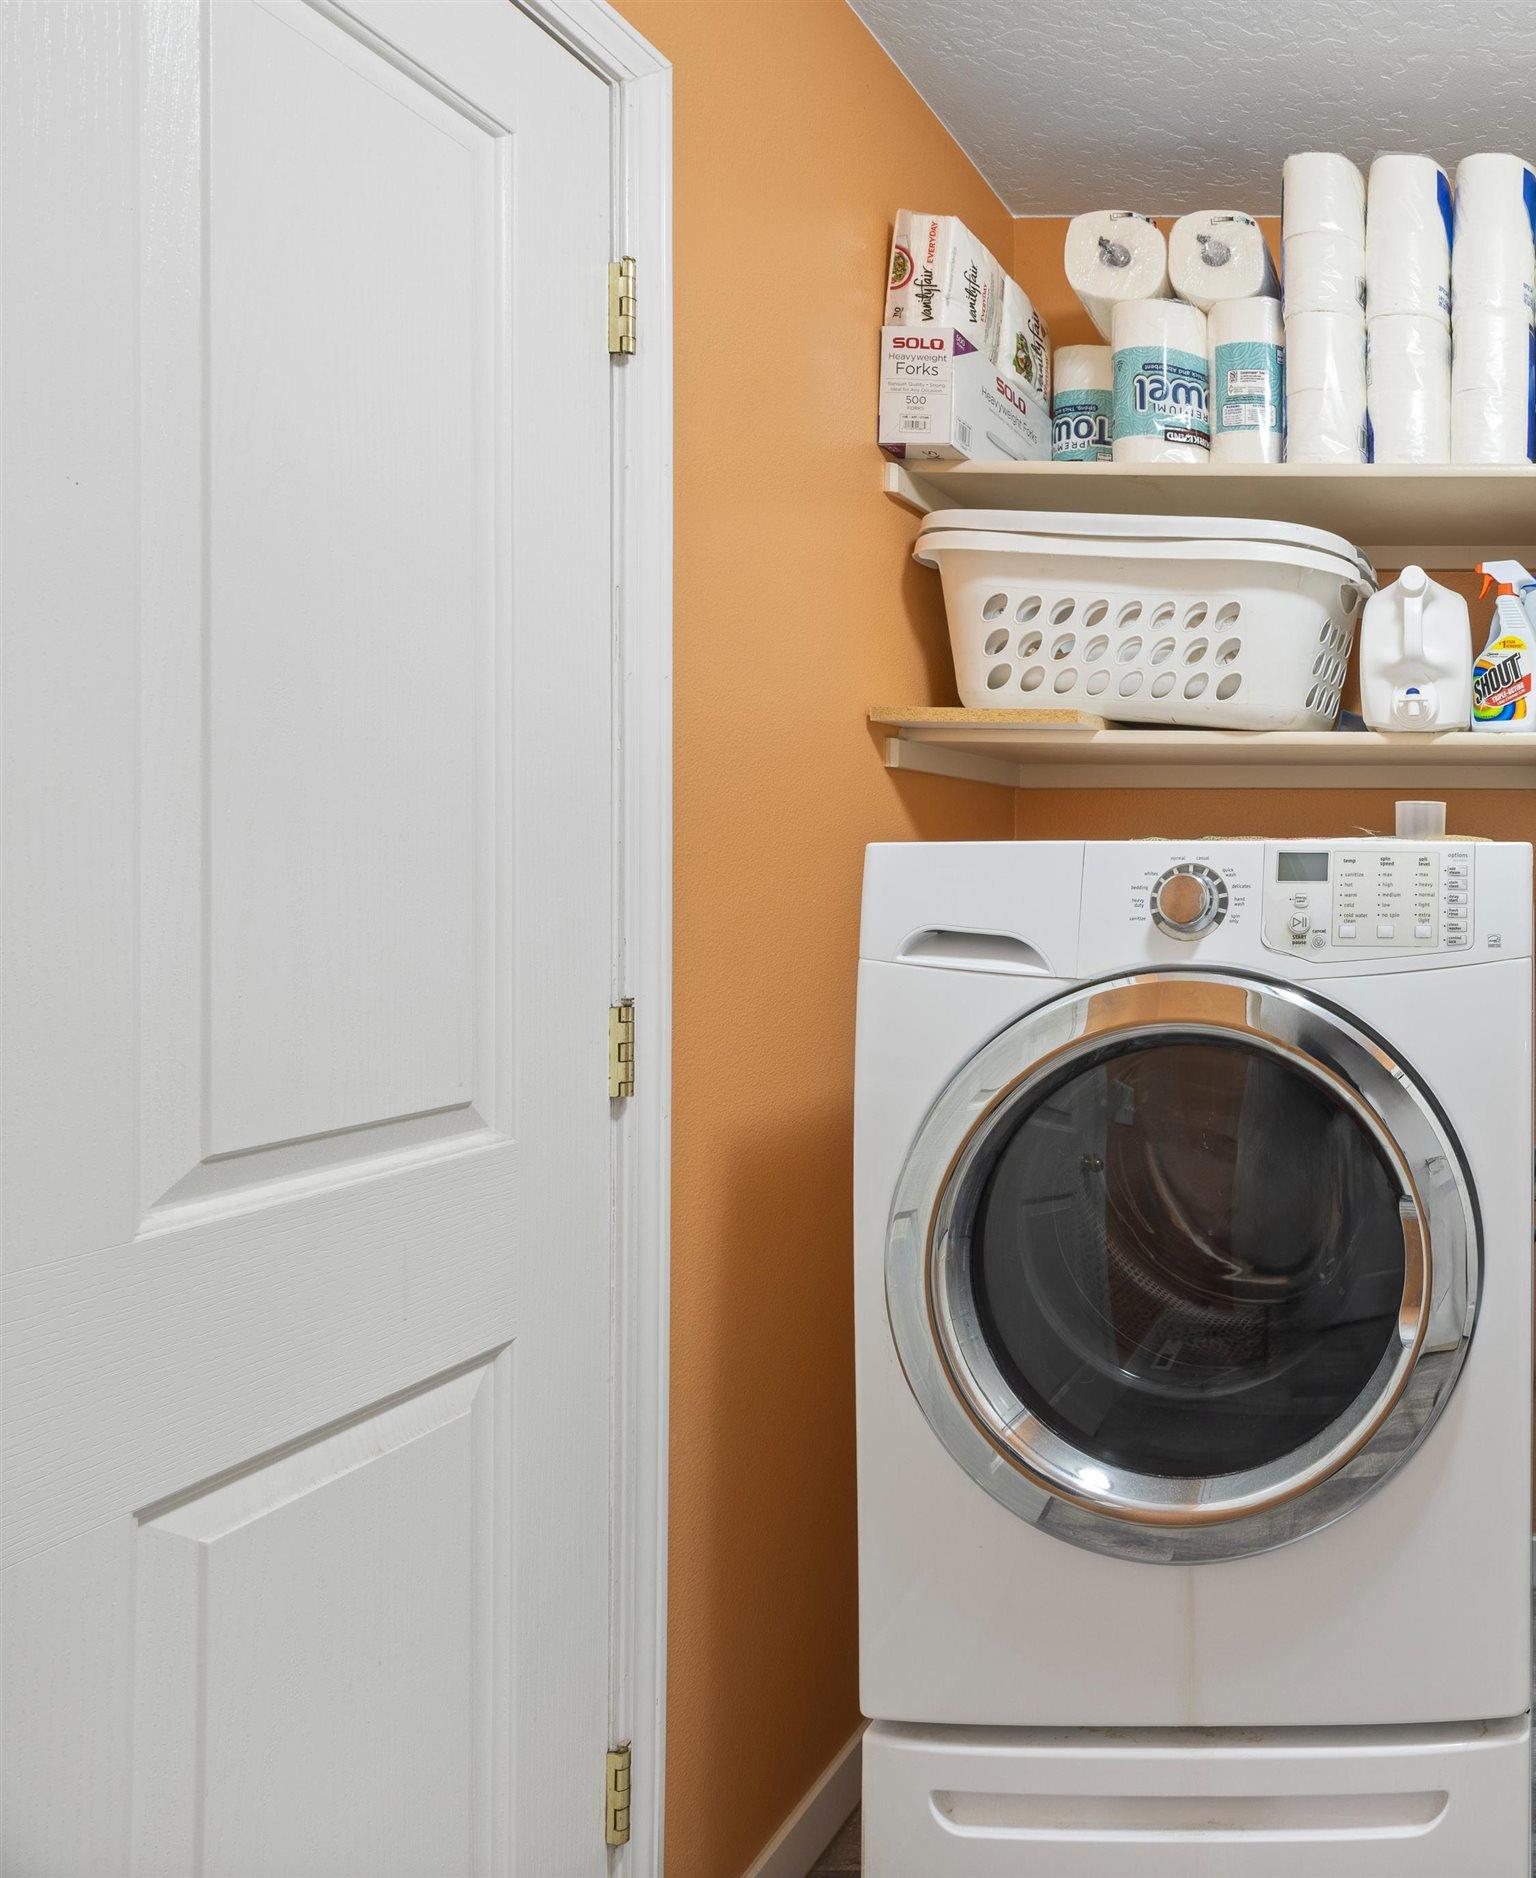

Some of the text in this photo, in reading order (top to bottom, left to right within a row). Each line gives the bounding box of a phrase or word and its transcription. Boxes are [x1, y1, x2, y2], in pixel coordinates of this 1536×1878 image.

[927, 221, 938, 263] EVERYDAY
[893, 337, 945, 350] SOLO
[888, 352, 947, 363] Heavyweight
[895, 362, 939, 376] Forks
[906, 396, 927, 405] 500
[995, 377, 1026, 416] SOLO
[1474, 653, 1521, 704] SHOUT
